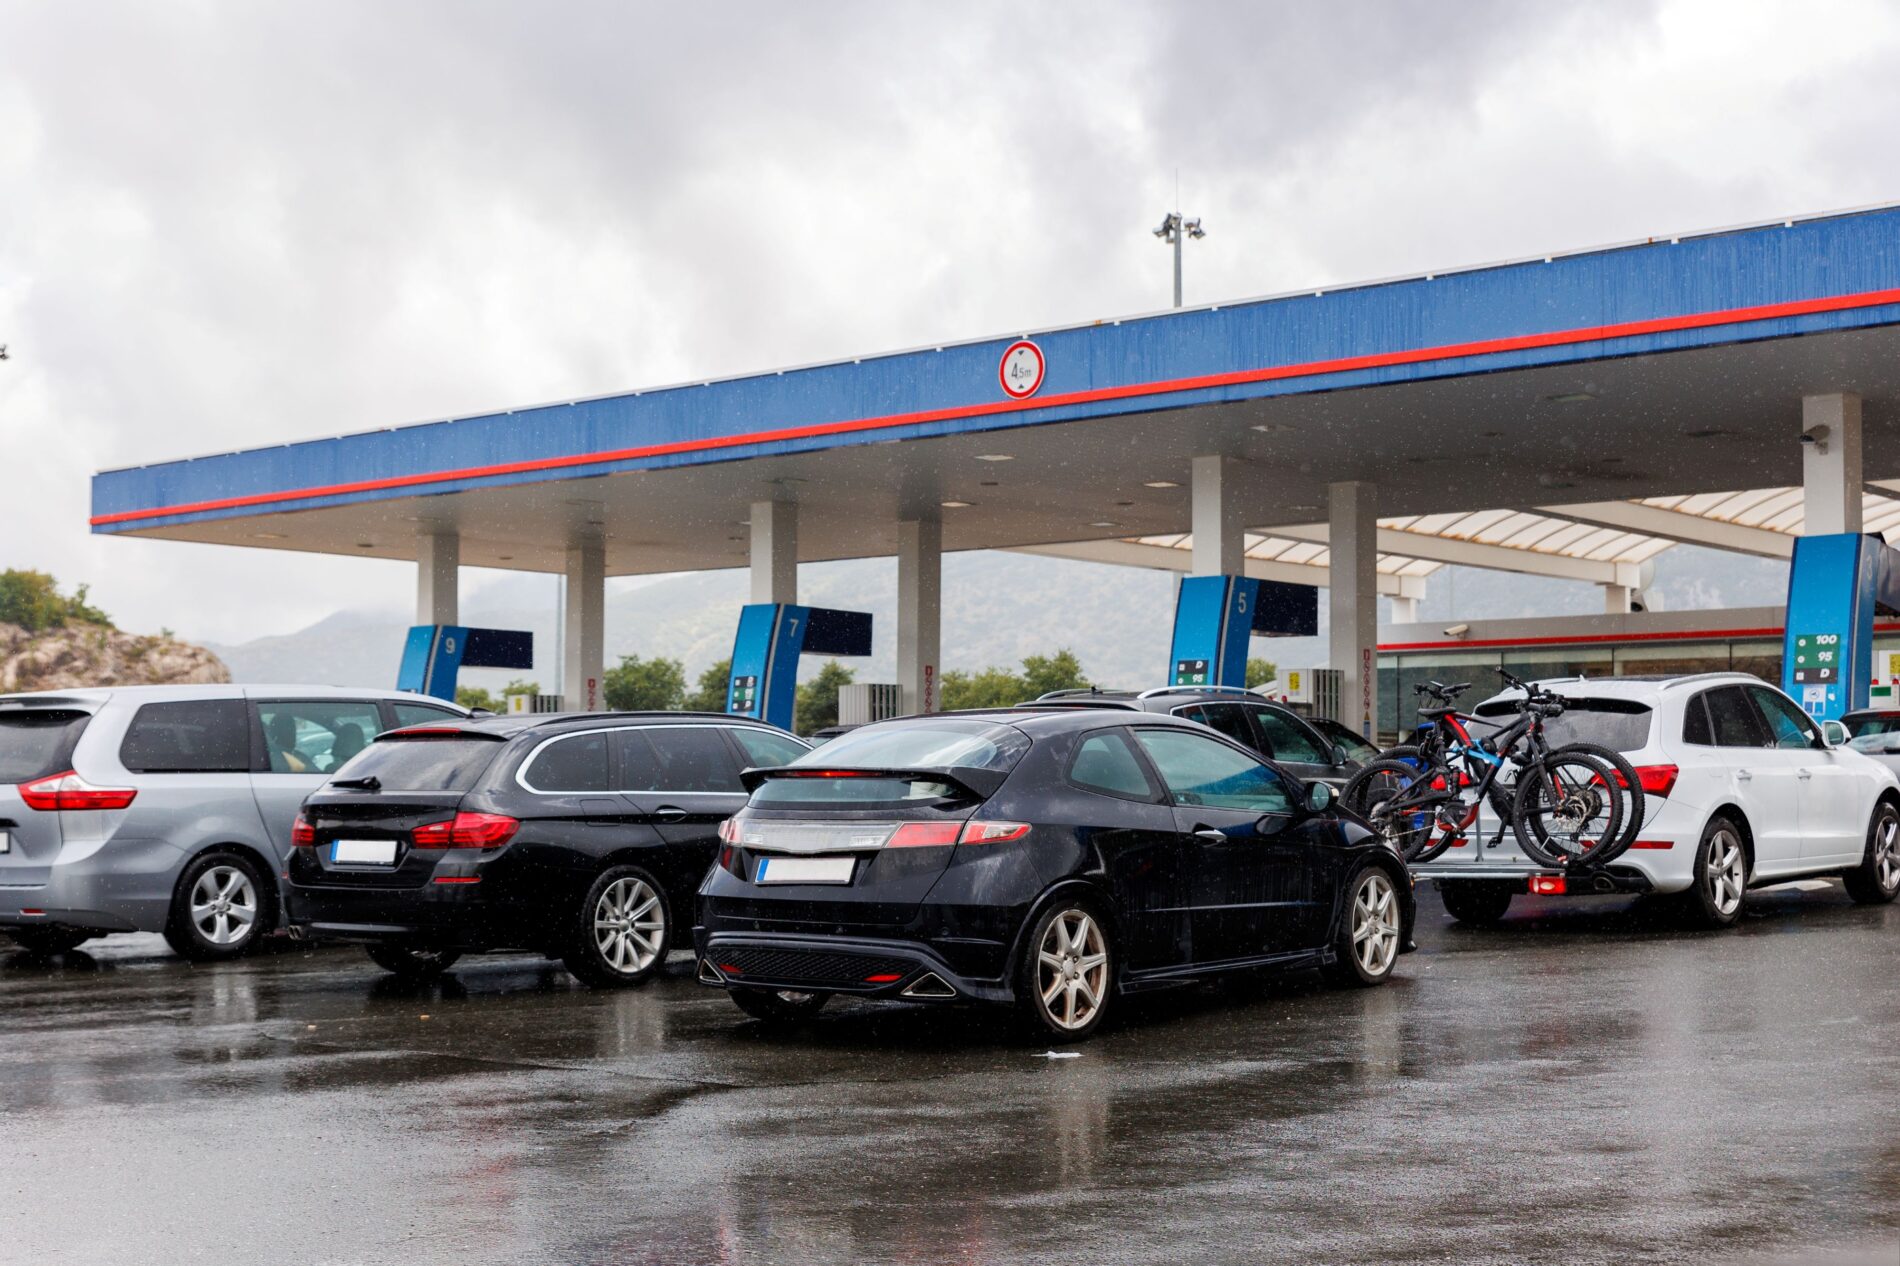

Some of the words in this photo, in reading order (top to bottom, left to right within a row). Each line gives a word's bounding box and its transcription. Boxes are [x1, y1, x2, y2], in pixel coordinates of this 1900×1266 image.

[1238, 592, 1247, 614] 5
[789, 618, 799, 637] 7
[1816, 634, 1837, 645] 100
[445, 637, 456, 654] 9
[1818, 651, 1833, 662] 95
[1195, 660, 1204, 669] D
[1192, 674, 1204, 683] 95
[1820, 668, 1830, 678] D
